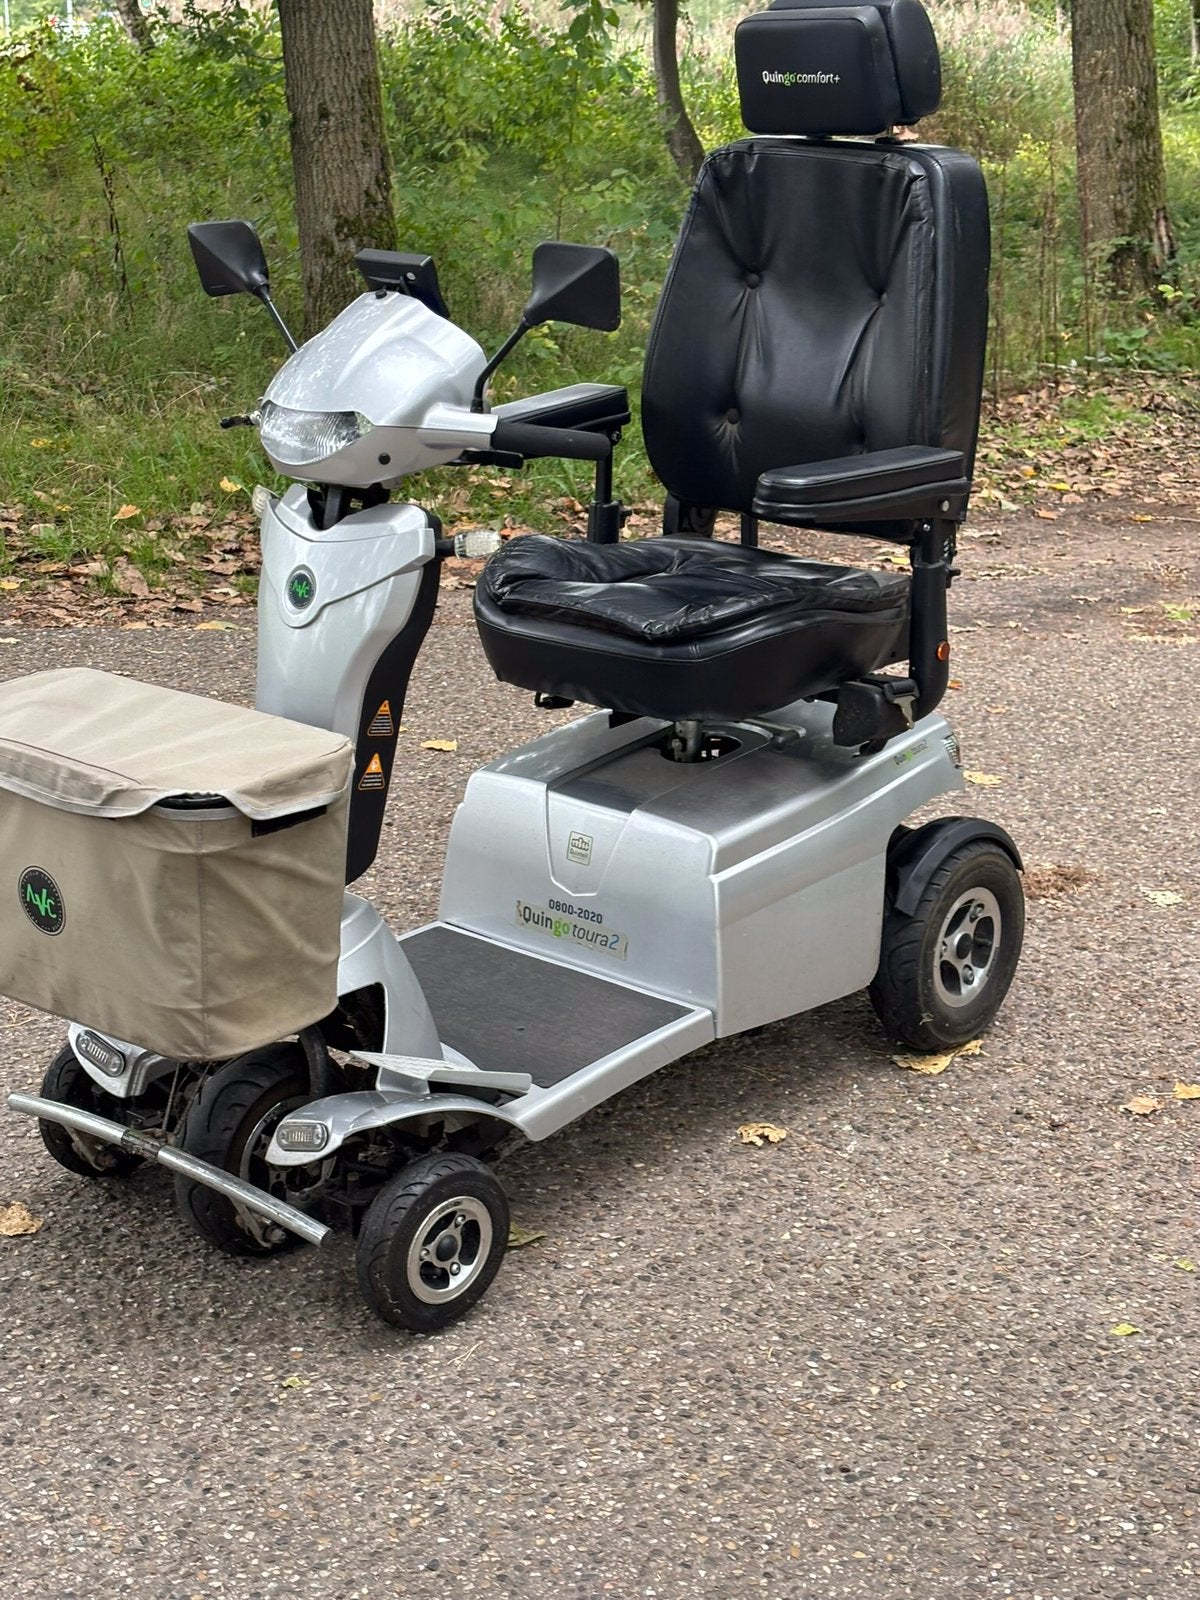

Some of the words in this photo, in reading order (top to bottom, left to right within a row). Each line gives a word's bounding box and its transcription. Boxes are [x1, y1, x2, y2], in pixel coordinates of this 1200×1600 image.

[762, 70, 796, 86] Quingo
[796, 70, 841, 84] comfort+
[548, 898, 604, 925] 0800-2020
[522, 905, 570, 938] Quingo
[572, 923, 621, 951] toura2
